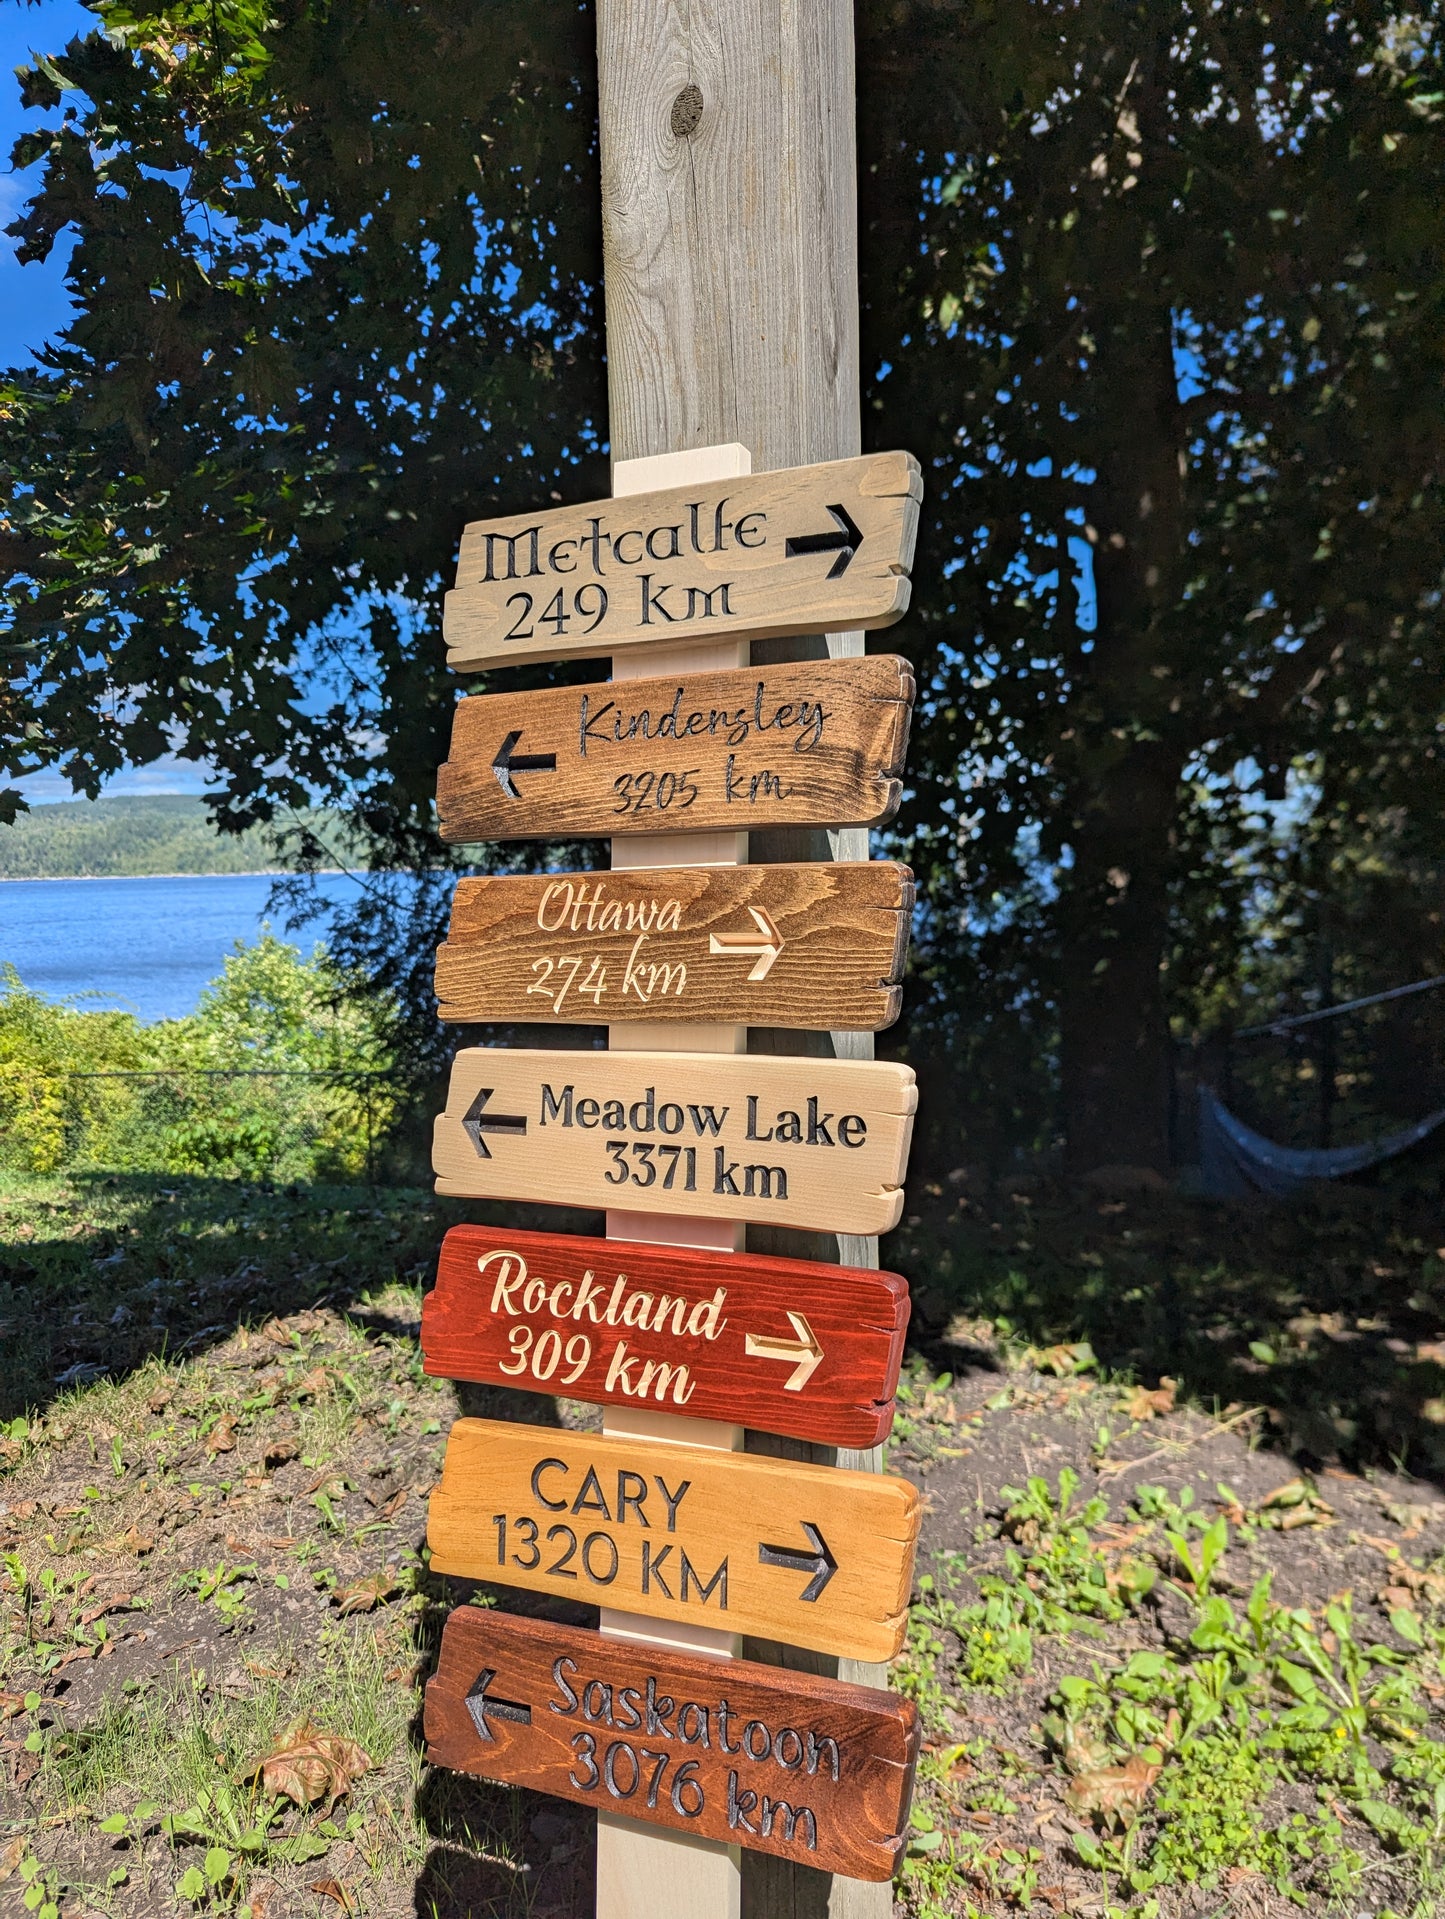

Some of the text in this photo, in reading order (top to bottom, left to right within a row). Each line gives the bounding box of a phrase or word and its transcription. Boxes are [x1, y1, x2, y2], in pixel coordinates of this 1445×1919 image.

[479, 499, 767, 583] Metcalfe
[504, 583, 608, 641] 249
[580, 681, 832, 757] Kindersley
[613, 754, 793, 813] 3205 km
[537, 881, 682, 932] Ottawa
[526, 934, 687, 1014] 274 km
[539, 1084, 867, 1148] Meadow Lake
[604, 1141, 789, 1199] 3371 km
[477, 1250, 728, 1341] Rockland
[499, 1324, 697, 1405] 309 km
[531, 1457, 691, 1533] CARY
[492, 1514, 728, 1610] 1320 KM
[549, 1656, 840, 1782] Saskatoon
[569, 1733, 817, 1851] 3076 km
